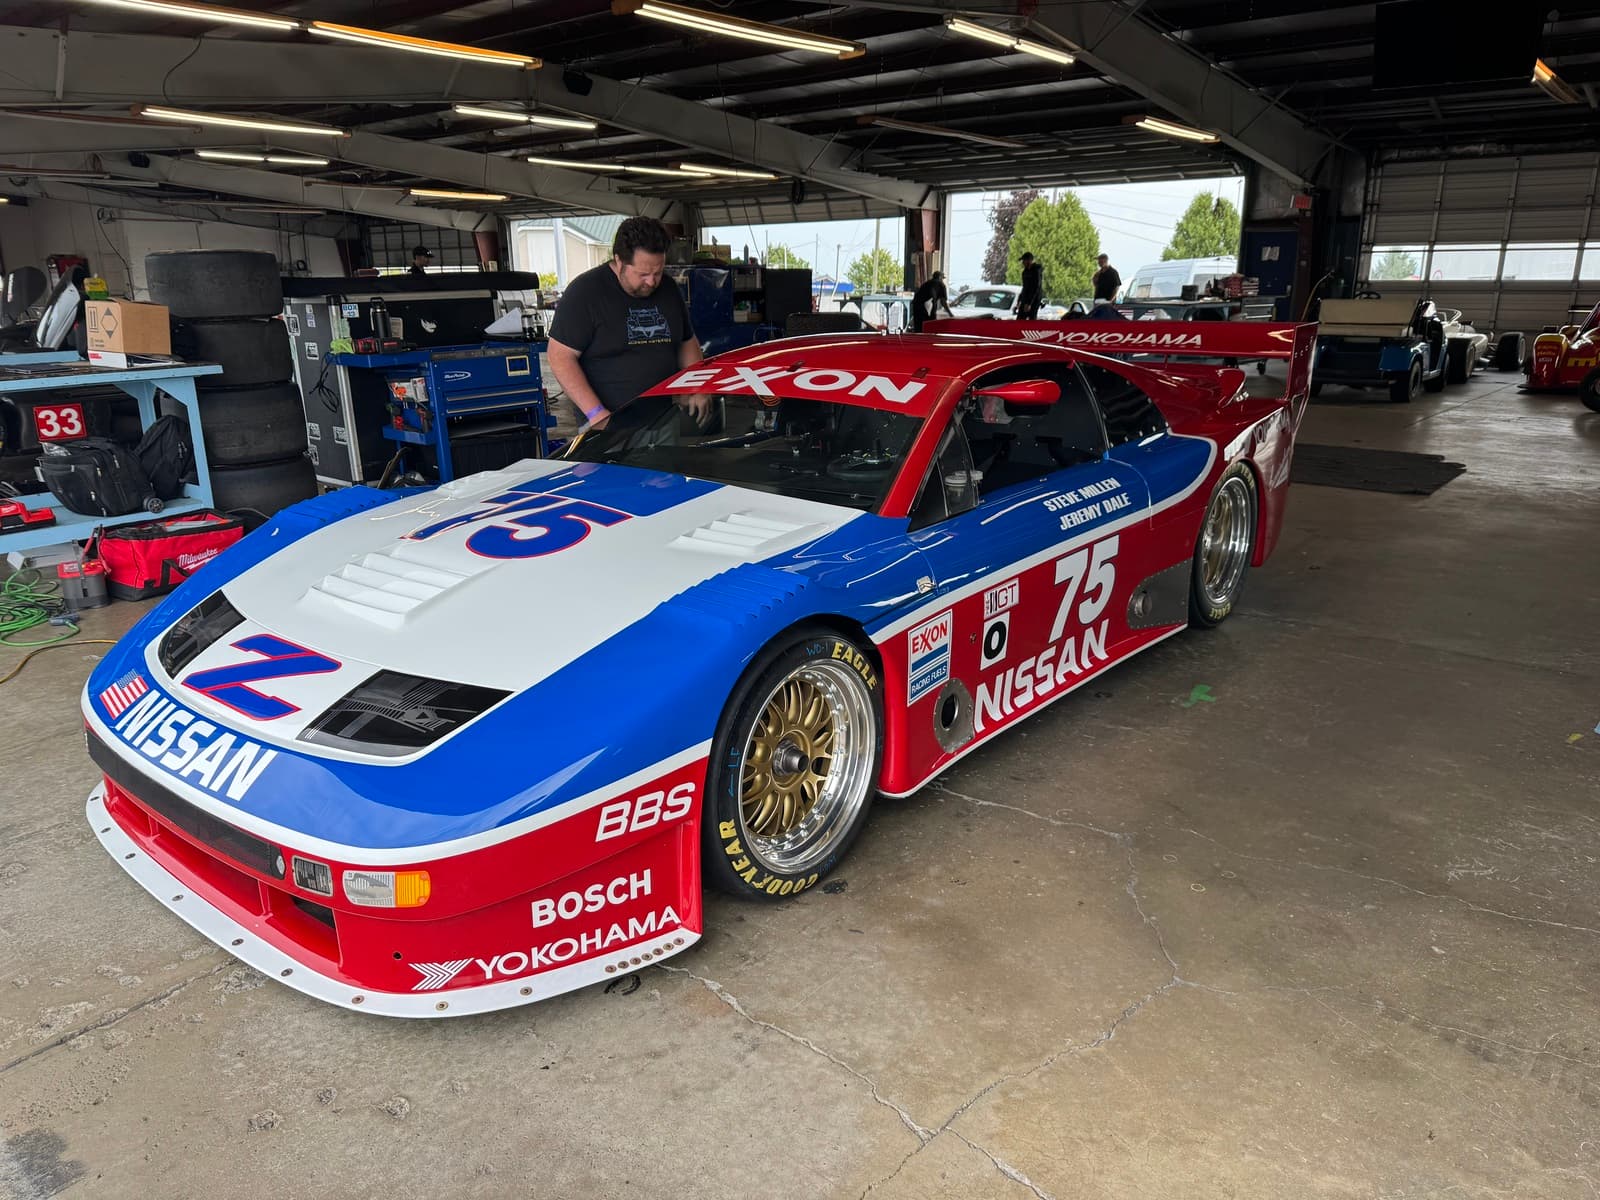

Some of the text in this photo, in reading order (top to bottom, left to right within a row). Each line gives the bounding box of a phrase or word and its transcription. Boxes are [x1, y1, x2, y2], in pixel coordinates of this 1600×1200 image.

[1056, 332, 1202, 346] YOKOHAMA
[666, 366, 927, 404] EXXON
[38, 408, 81, 437] 33
[1043, 477, 1121, 511] STEVE MILLEN
[1060, 493, 1132, 530] JEREMY DALE
[177, 548, 217, 567] Milwaukee
[1049, 534, 1119, 643] 75
[912, 620, 947, 653] EXXON
[181, 634, 342, 721] Z
[832, 642, 877, 690] EAGLE
[912, 666, 947, 694] RACING FUELS
[974, 619, 1109, 733] NISSAN
[115, 689, 278, 801] NISSAN
[595, 782, 696, 842] BBS
[531, 868, 652, 928] BOSCH
[475, 905, 682, 979] YOKOHAMA
